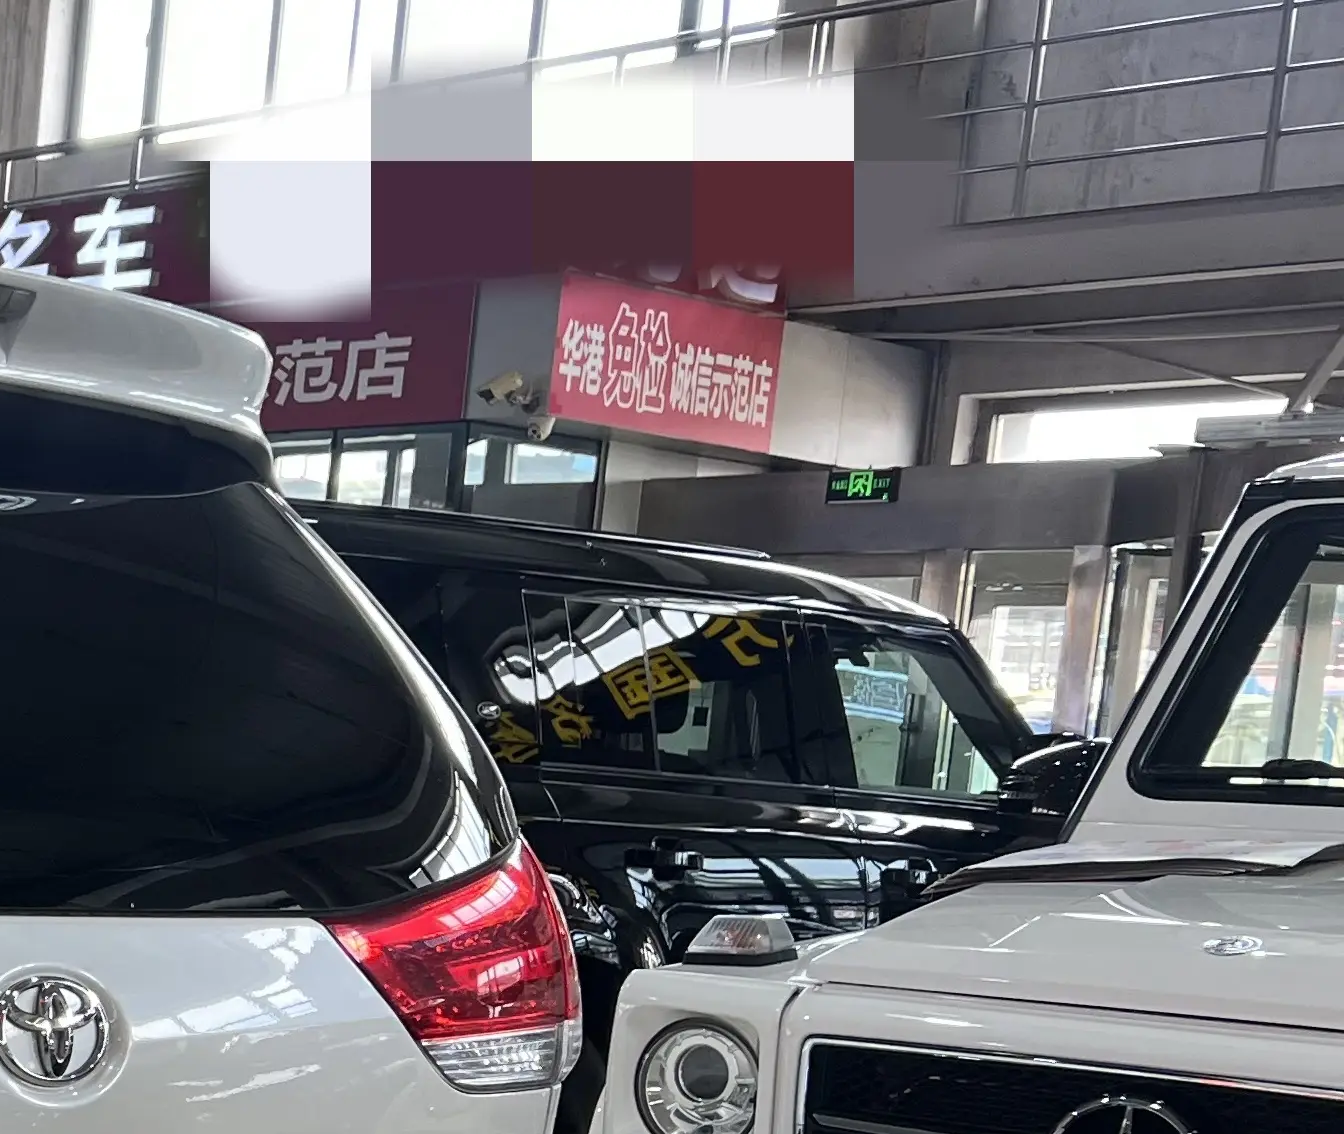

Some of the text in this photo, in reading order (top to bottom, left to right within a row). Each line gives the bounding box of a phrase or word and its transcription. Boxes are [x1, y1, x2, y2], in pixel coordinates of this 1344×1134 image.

[267, 332, 412, 406] 范店
[559, 302, 773, 428] 华港免检诚信示范店
